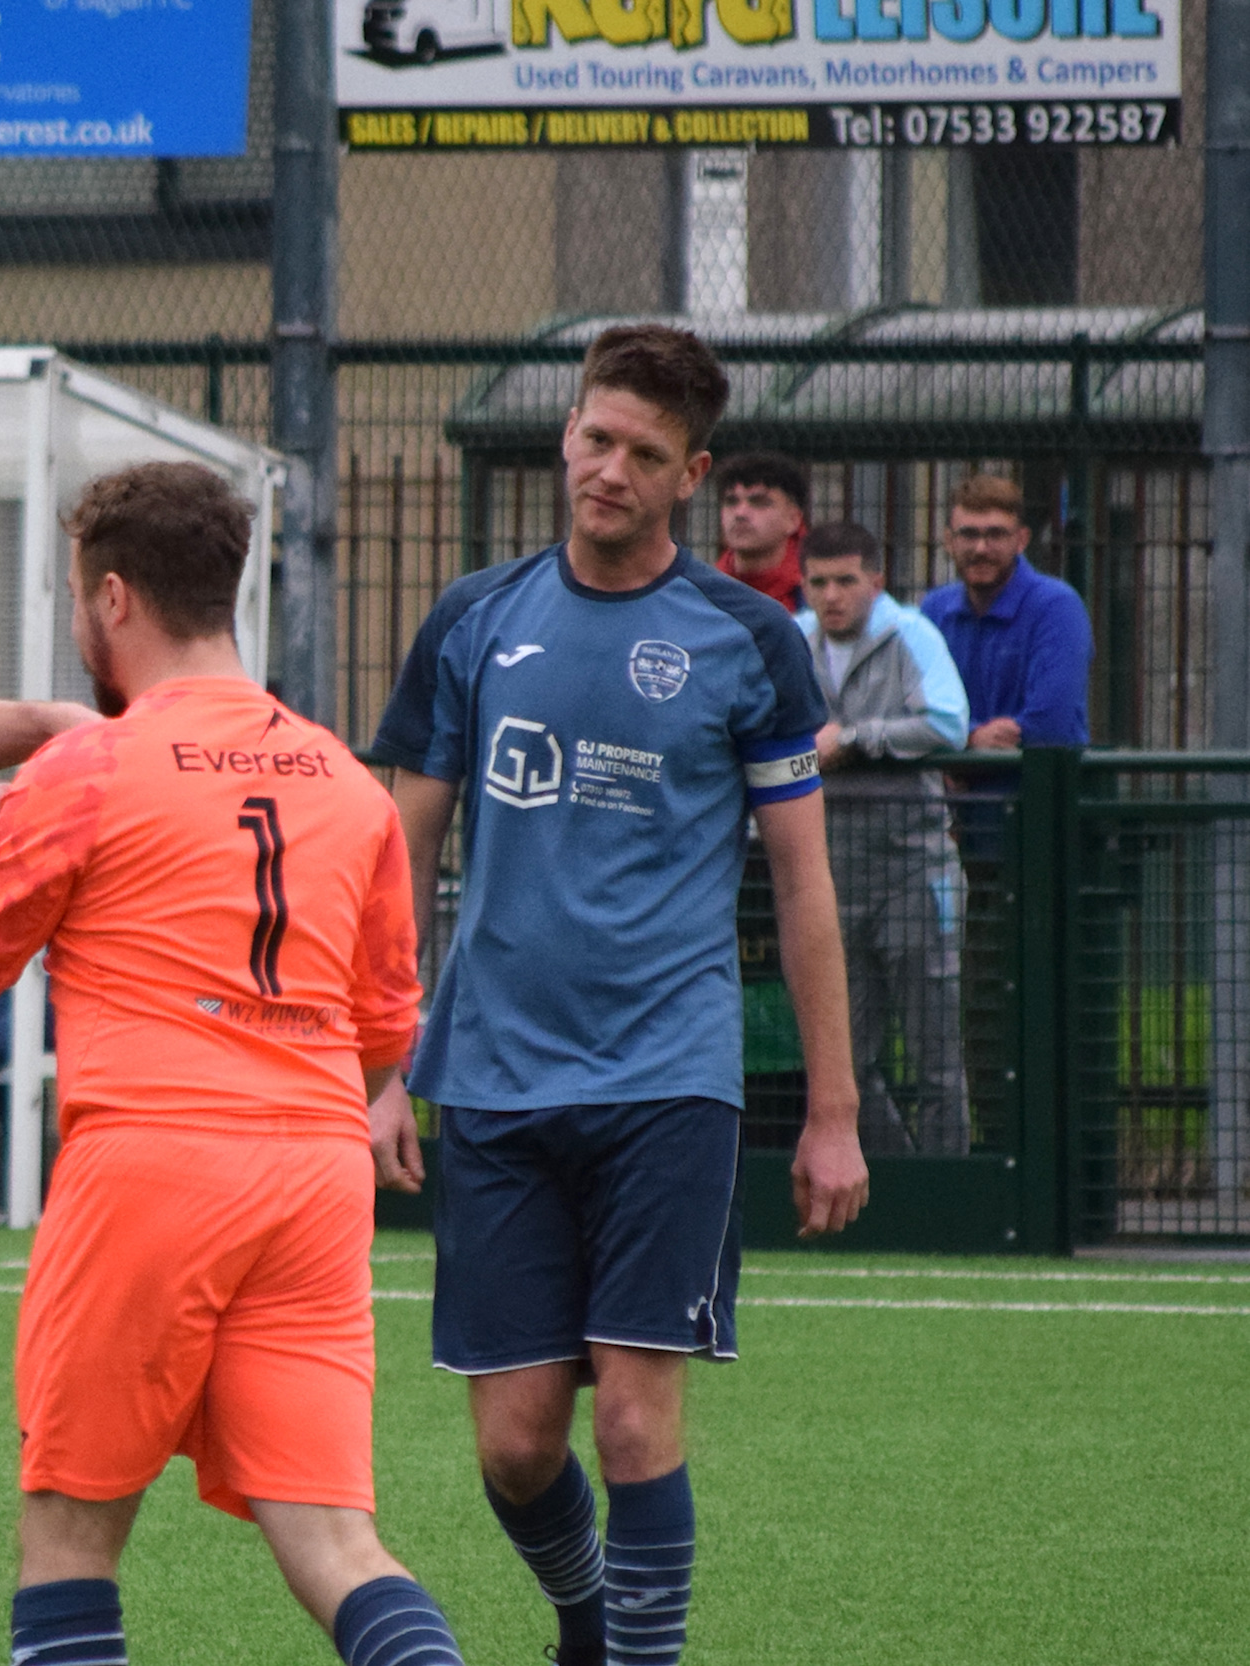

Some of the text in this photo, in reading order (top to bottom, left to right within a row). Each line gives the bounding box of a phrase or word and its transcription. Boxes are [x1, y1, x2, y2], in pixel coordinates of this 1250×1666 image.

[516, 56, 1158, 93] Used Touring Caravans, Motorhomes & Campers
[350, 111, 416, 146] SALES
[434, 111, 528, 146] REPAIRS
[548, 110, 649, 144] DELIVERY
[675, 109, 809, 142] COLLECTION
[830, 103, 1167, 146] Tel: 07533 922587
[171, 742, 334, 779] Everest
[576, 756, 662, 784] MAINTENANCE
[577, 740, 664, 768] GJ PROPERTY
[238, 796, 290, 998] 1
